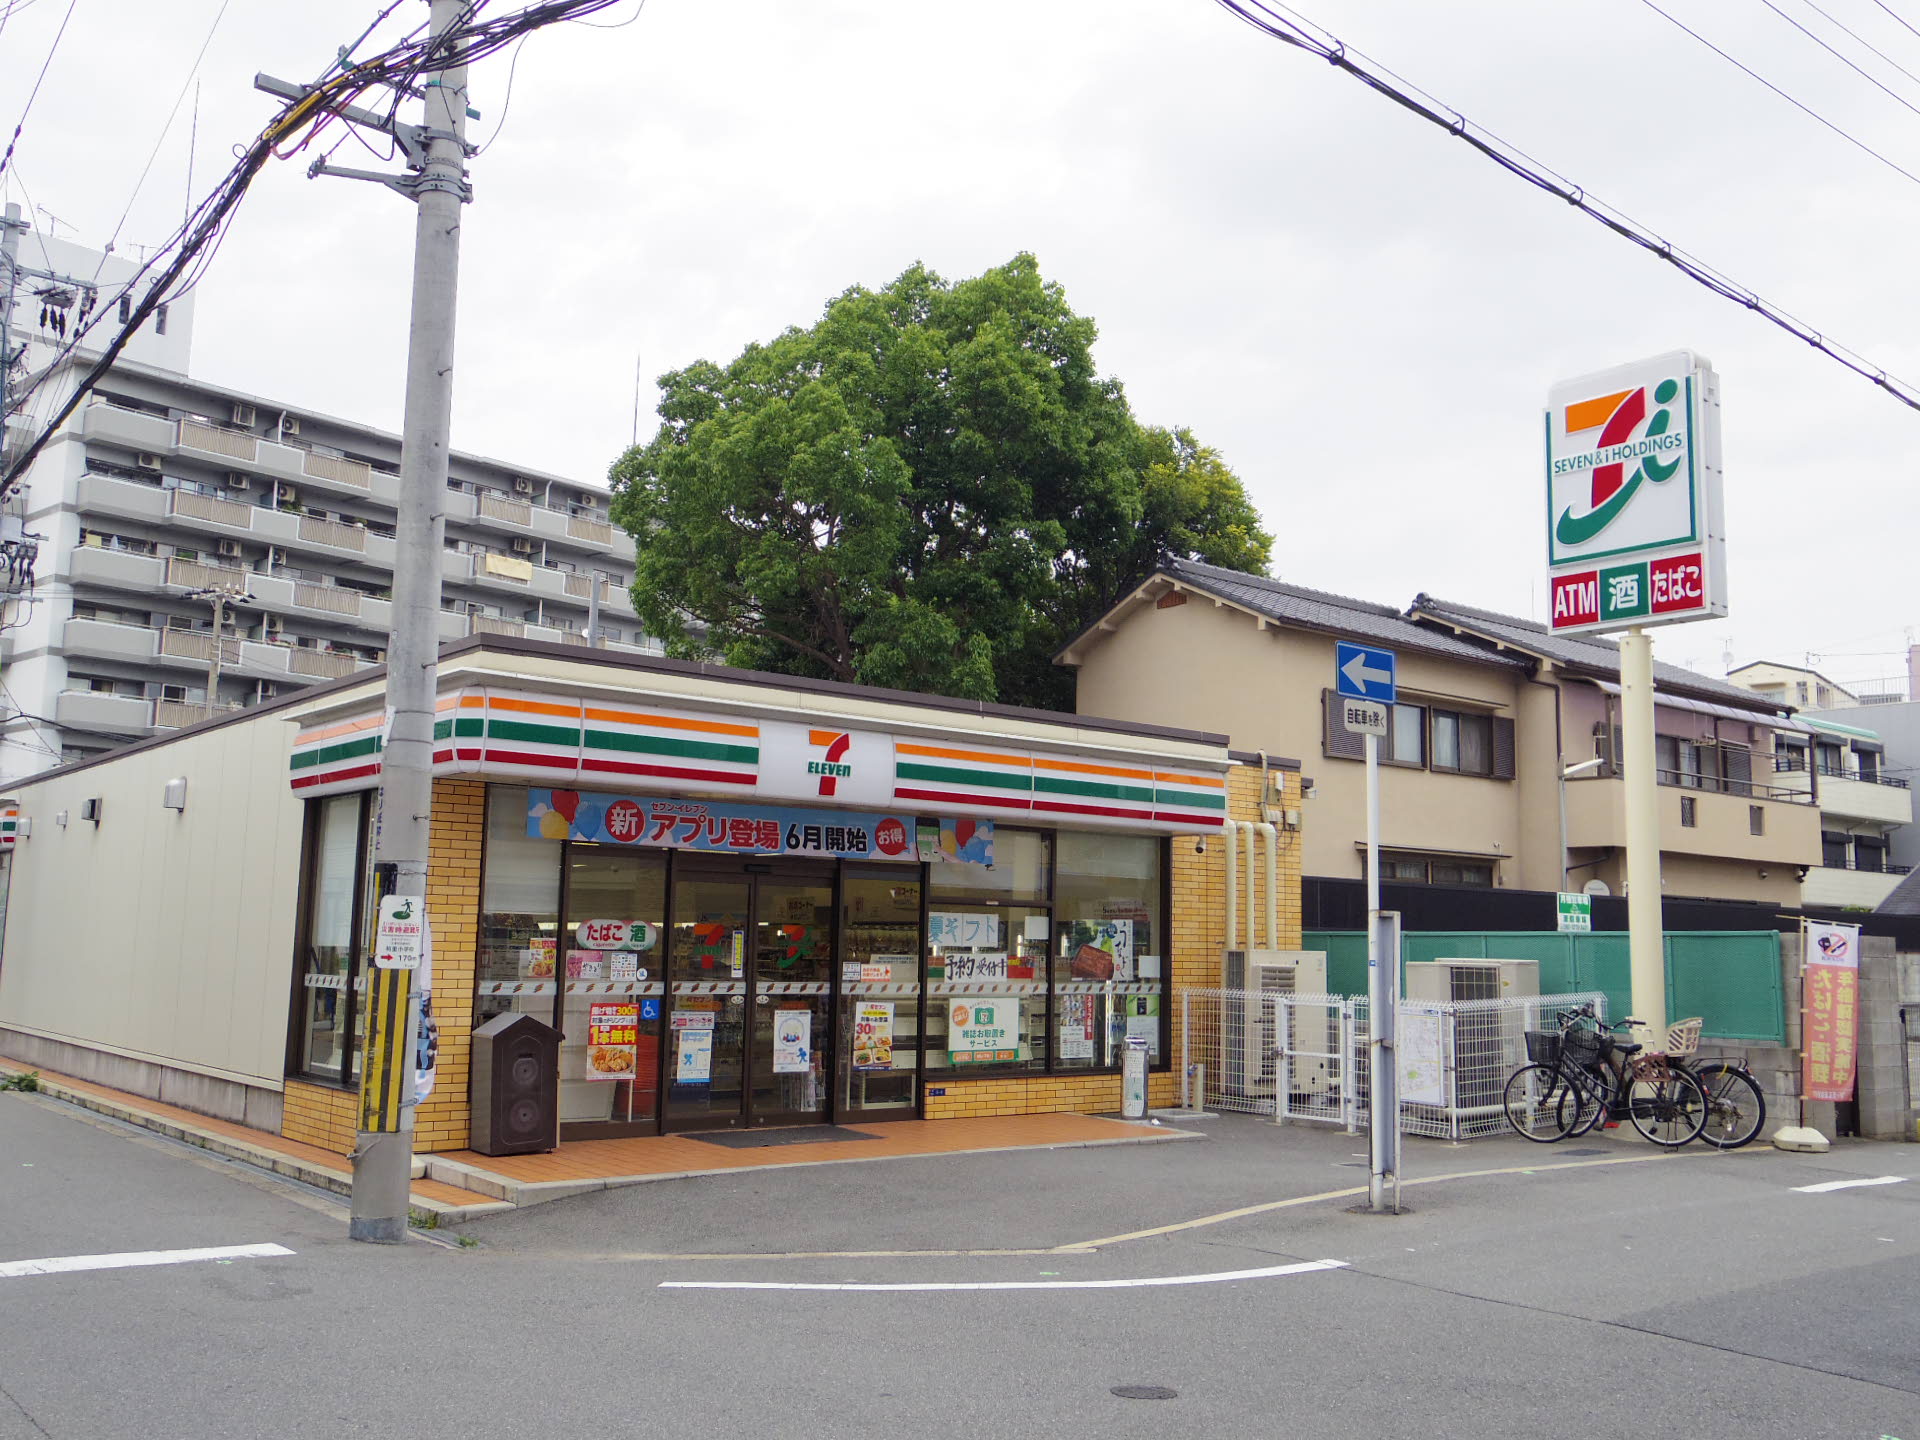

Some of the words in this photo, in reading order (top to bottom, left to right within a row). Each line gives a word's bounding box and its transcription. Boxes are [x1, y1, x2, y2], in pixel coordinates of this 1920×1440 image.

[1554, 453, 1593, 473] SEVEN
[1612, 433, 1682, 461] HOLDINGS
[1554, 580, 1596, 618] ATM
[1609, 574, 1639, 611] 酒
[1652, 566, 1702, 604] たばこ
[1347, 707, 1384, 728] 自転車を除く
[610, 806, 638, 836] 新
[651, 814, 780, 850] アプリ登場
[786, 824, 868, 852] 6月開始
[878, 827, 904, 844] お得
[587, 924, 623, 942] たばこ
[630, 924, 647, 942] 酒
[970, 1040, 997, 1048] サービス
